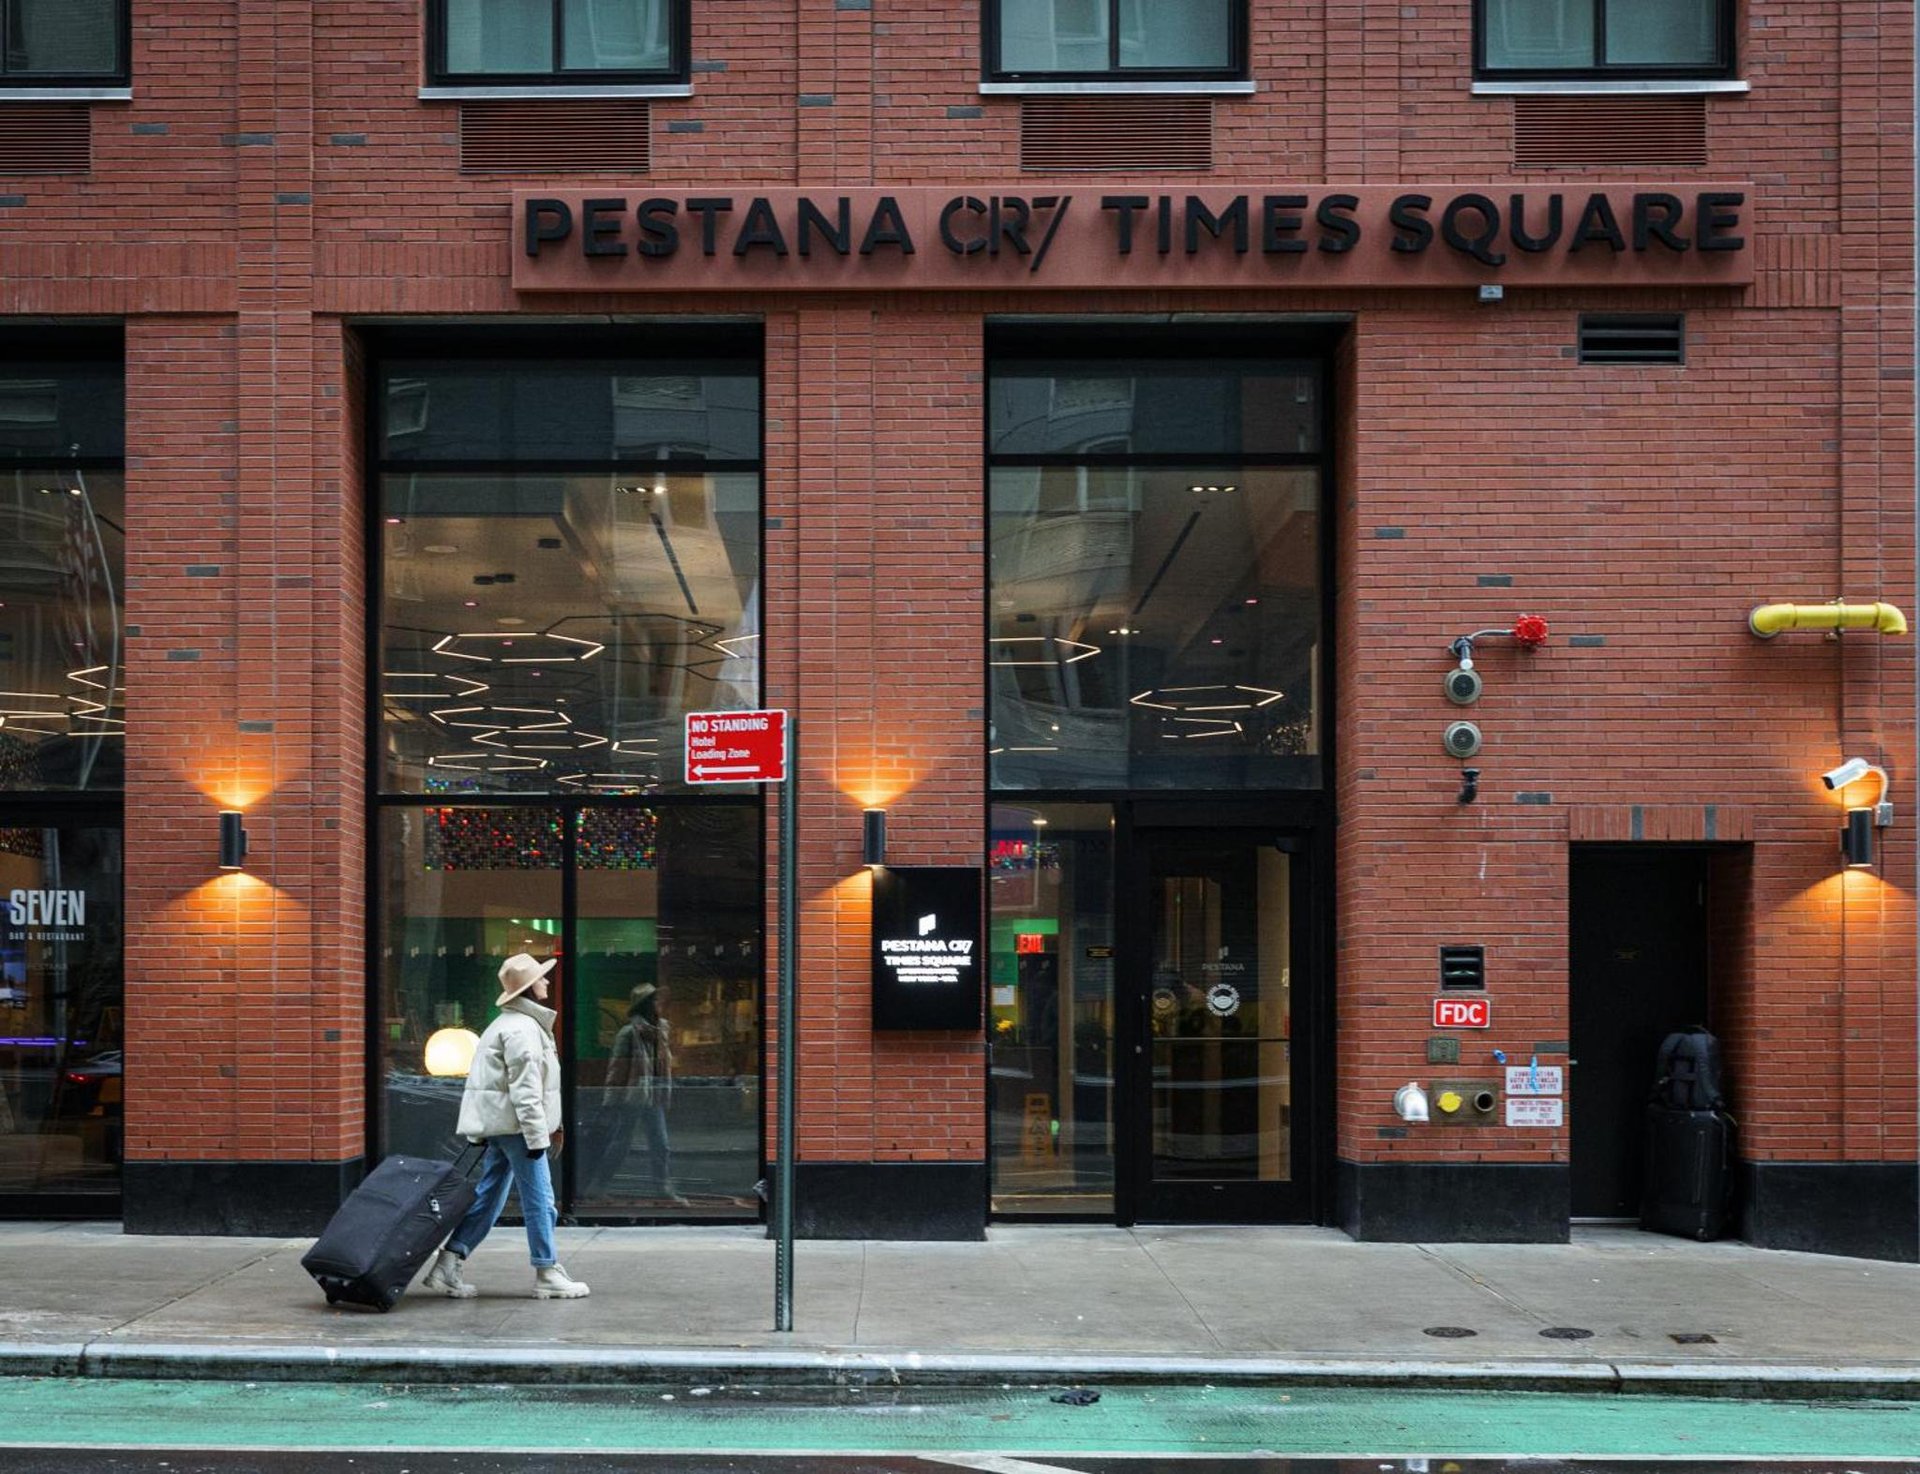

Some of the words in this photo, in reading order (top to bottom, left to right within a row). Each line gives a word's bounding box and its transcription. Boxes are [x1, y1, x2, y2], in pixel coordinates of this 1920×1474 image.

[525, 196, 915, 258] PESTANA
[938, 195, 1073, 272] CR7
[1101, 194, 1361, 255] TIMES
[1389, 193, 1745, 266] SQUARE
[691, 720, 709, 733] NO
[710, 717, 769, 732] STANDING
[691, 736, 717, 747] Hotel
[691, 748, 727, 761] Loading
[727, 748, 751, 759] Zone
[10, 889, 85, 925] SEVEN
[881, 939, 948, 952] PESTANA
[884, 955, 921, 966] TIMES
[921, 955, 972, 968] SQUARE
[1440, 1003, 1483, 1024] FDC
